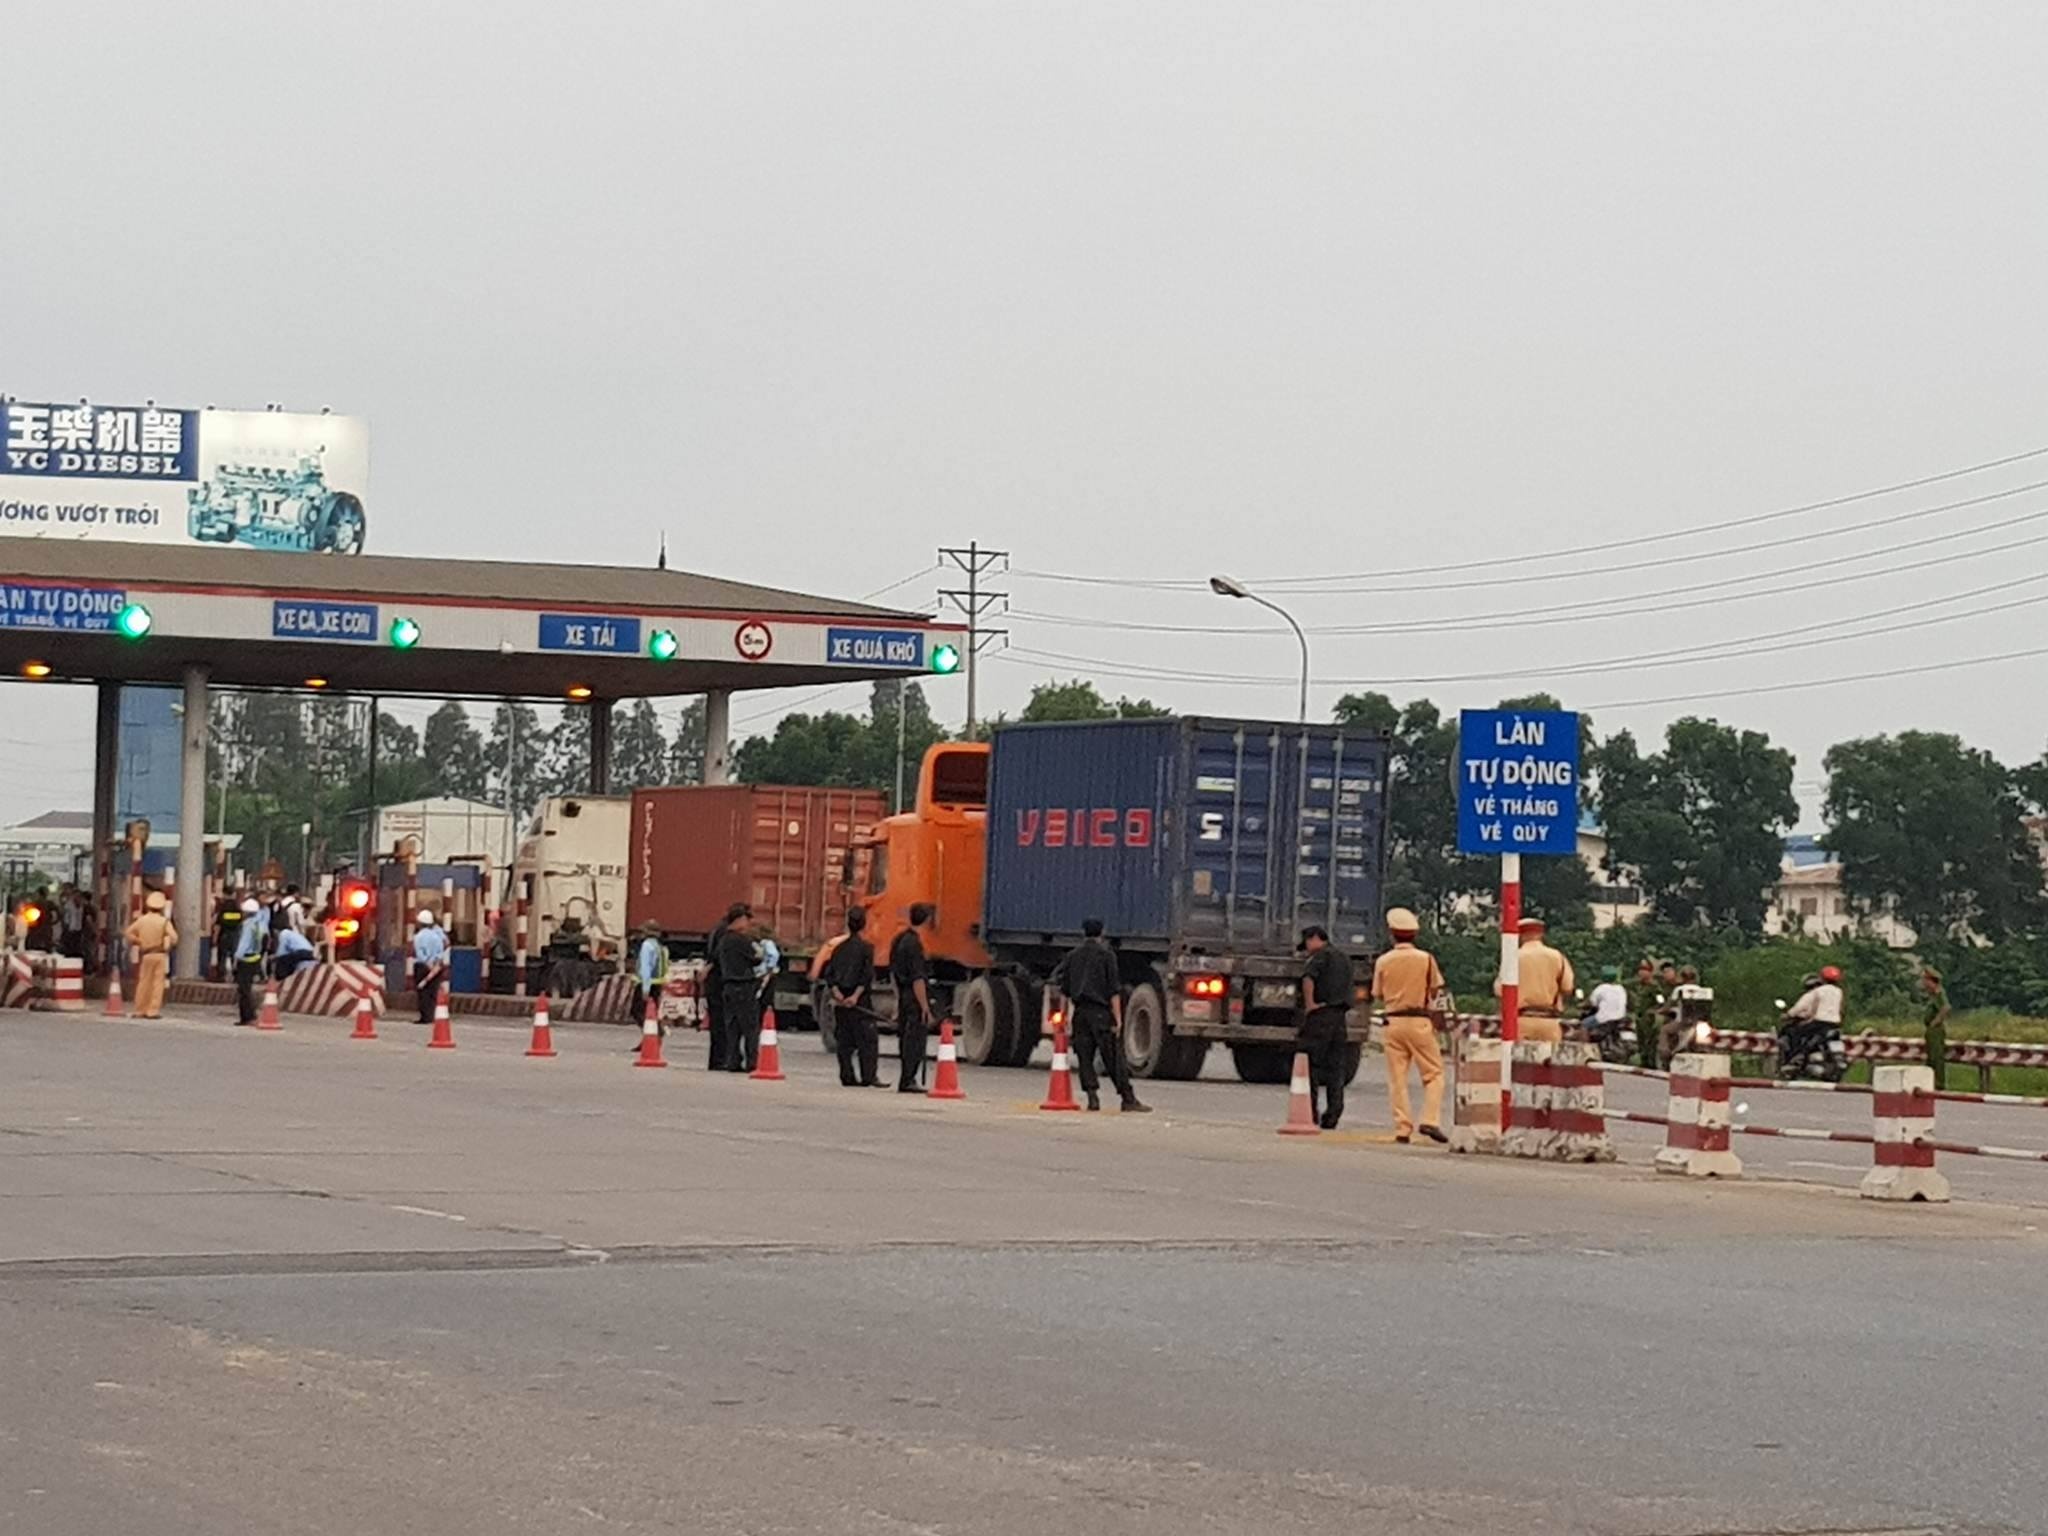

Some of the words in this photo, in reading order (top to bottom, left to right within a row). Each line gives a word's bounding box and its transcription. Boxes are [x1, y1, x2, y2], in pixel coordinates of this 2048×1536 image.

[8, 406, 182, 453] 玉柴机器
[8, 451, 48, 469] YC
[60, 453, 181, 474] DIESEL
[278, 608, 296, 630] XE
[565, 623, 585, 645] XE
[833, 639, 850, 658] XE
[854, 636, 883, 659] QUÁ
[1495, 714, 1545, 745] LÀN
[1465, 757, 1500, 790] TỰ
[1503, 755, 1572, 791] ĐỘNG
[1500, 795, 1559, 816] THÁNG
